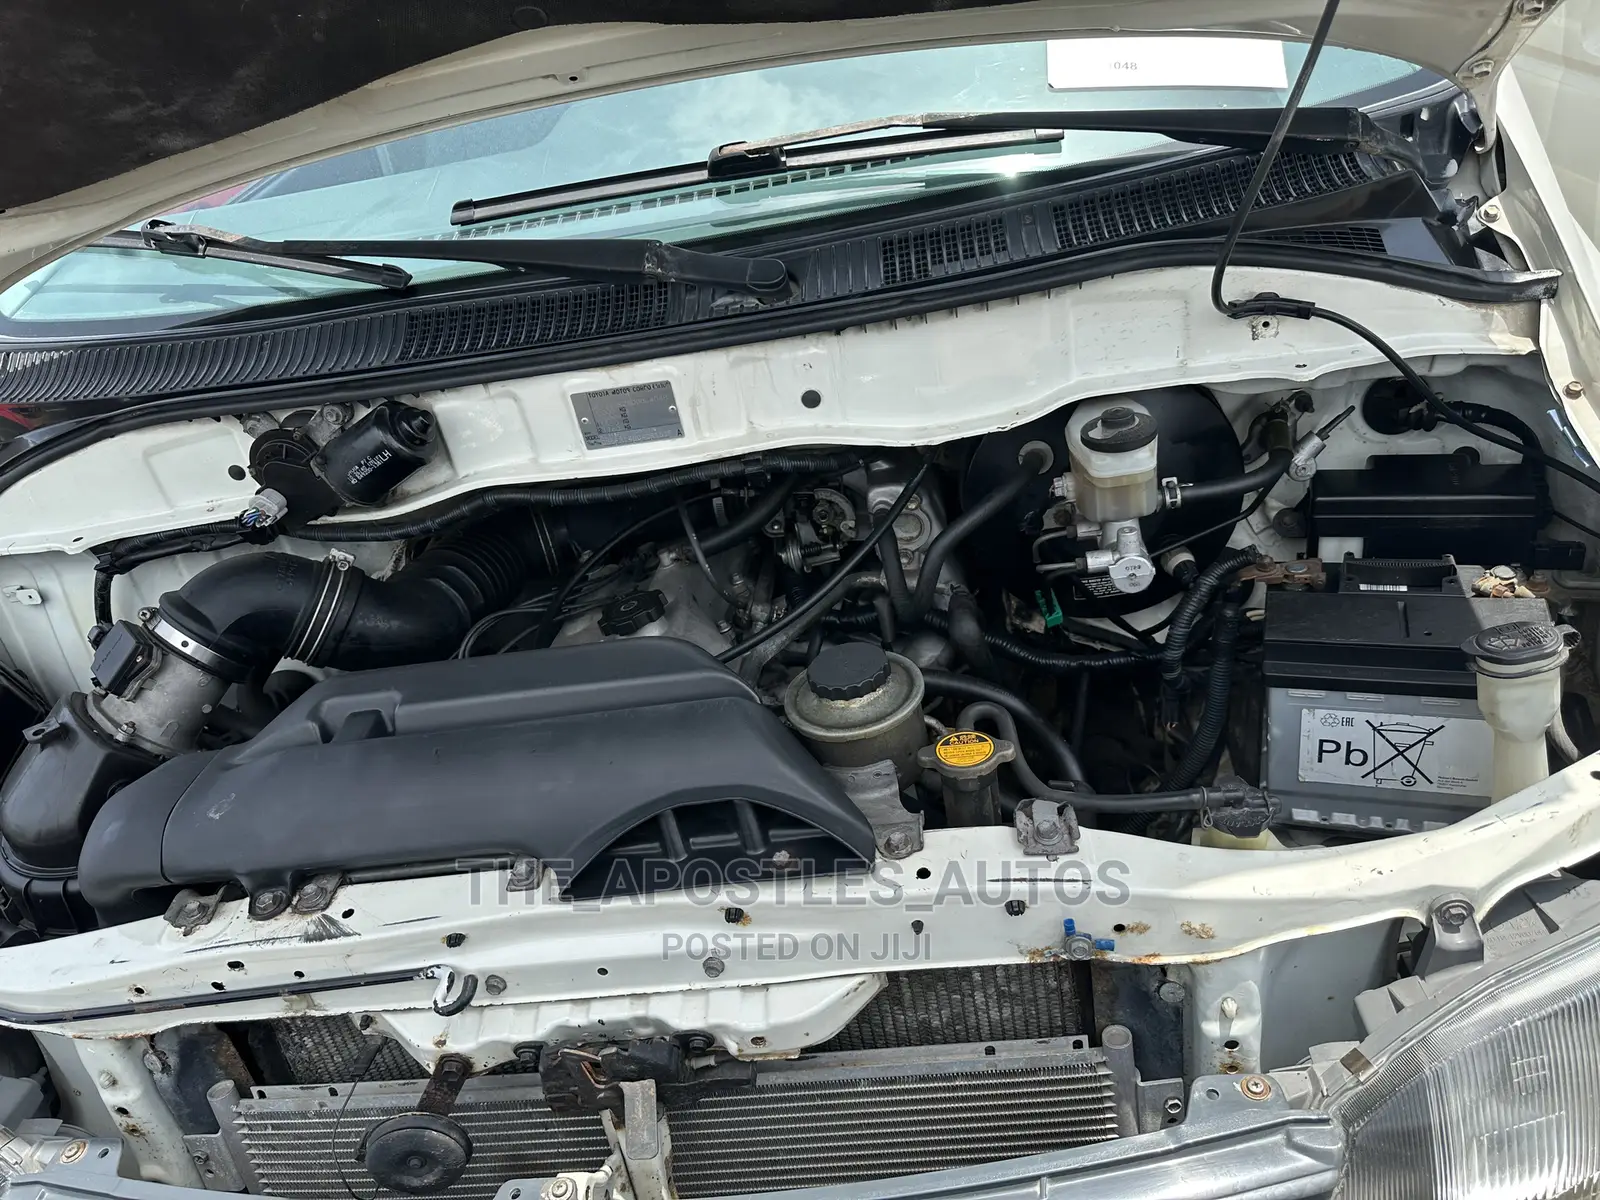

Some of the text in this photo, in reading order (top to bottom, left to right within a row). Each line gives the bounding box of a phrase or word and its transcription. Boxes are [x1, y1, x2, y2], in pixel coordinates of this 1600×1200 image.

[588, 390, 609, 398] TOYOTA
[612, 387, 630, 395] MOTOR
[1341, 717, 1355, 727] EAC
[1317, 739, 1369, 767] Pb
